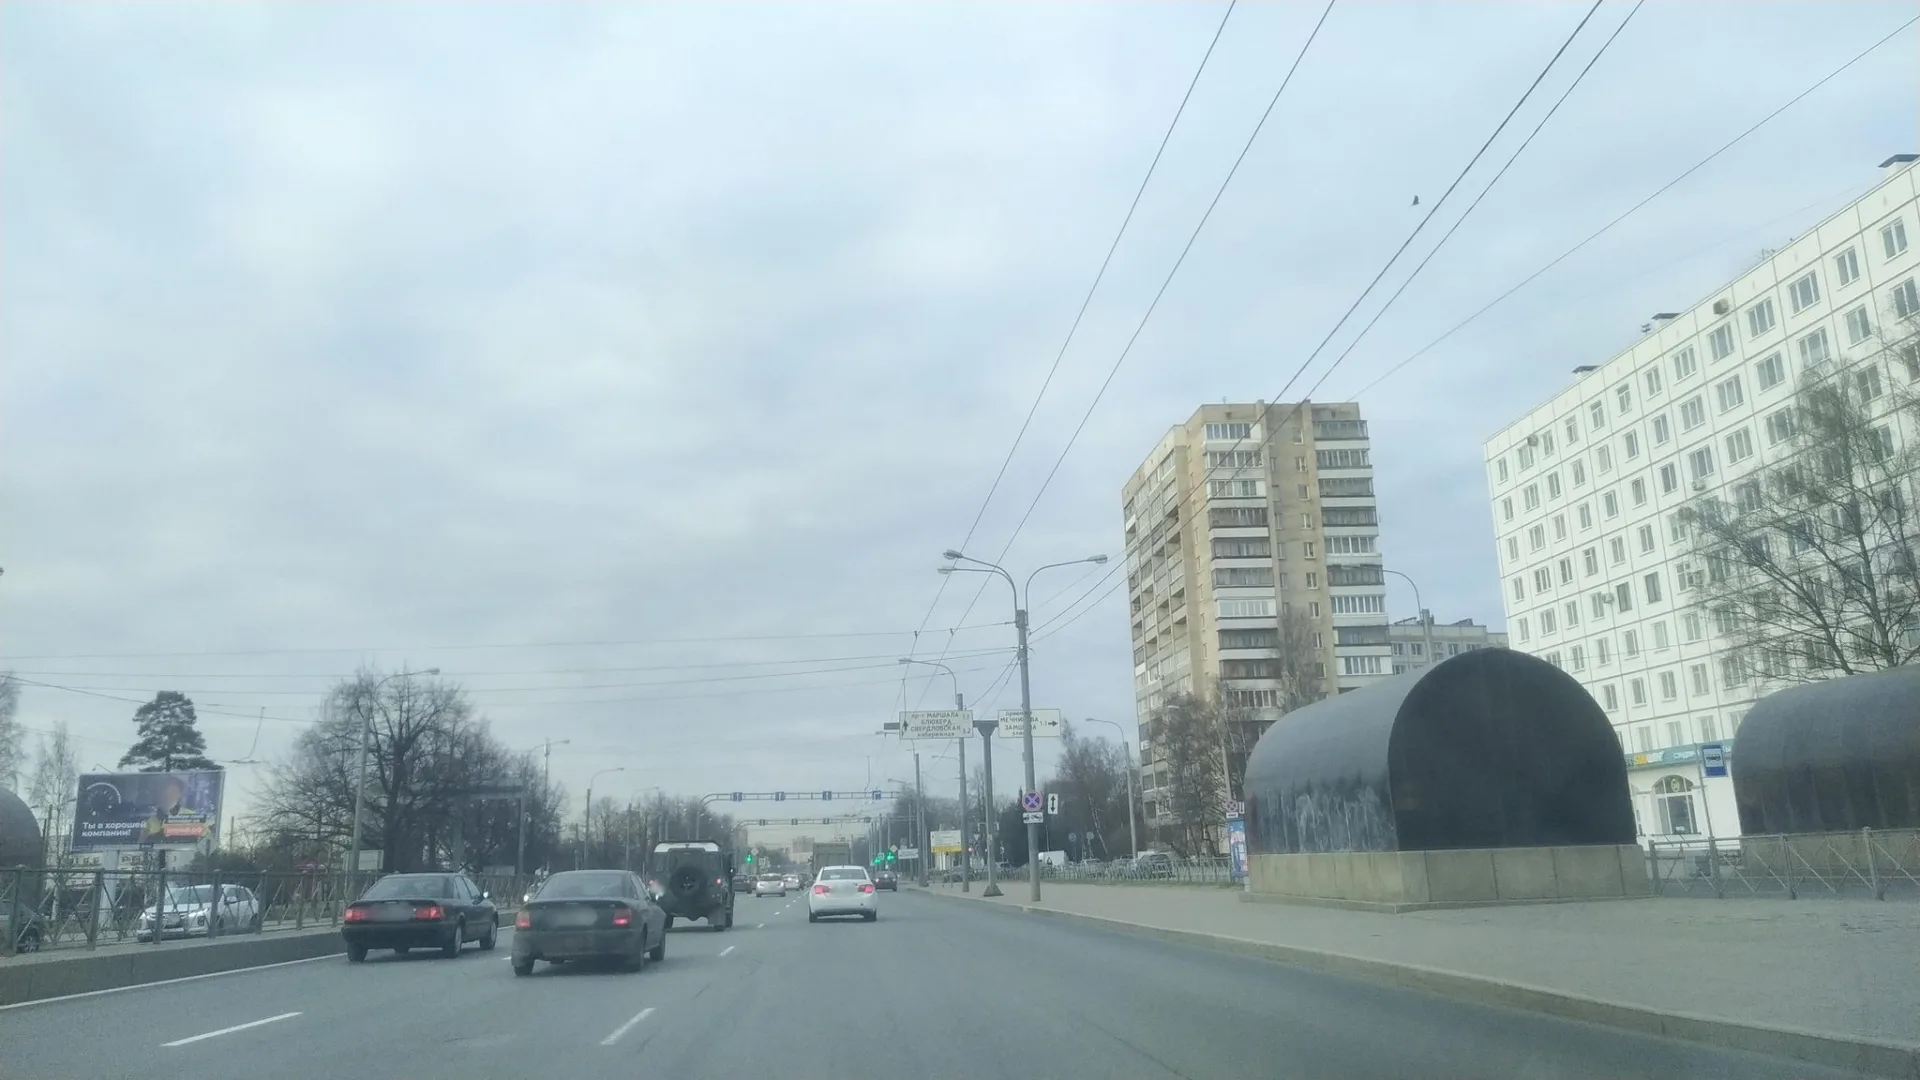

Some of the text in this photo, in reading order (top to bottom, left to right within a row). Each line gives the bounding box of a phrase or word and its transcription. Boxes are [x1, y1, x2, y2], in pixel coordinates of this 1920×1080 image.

[83, 821, 96, 830] Ты
[105, 821, 147, 829] хорошей
[82, 829, 131, 837] компании!
